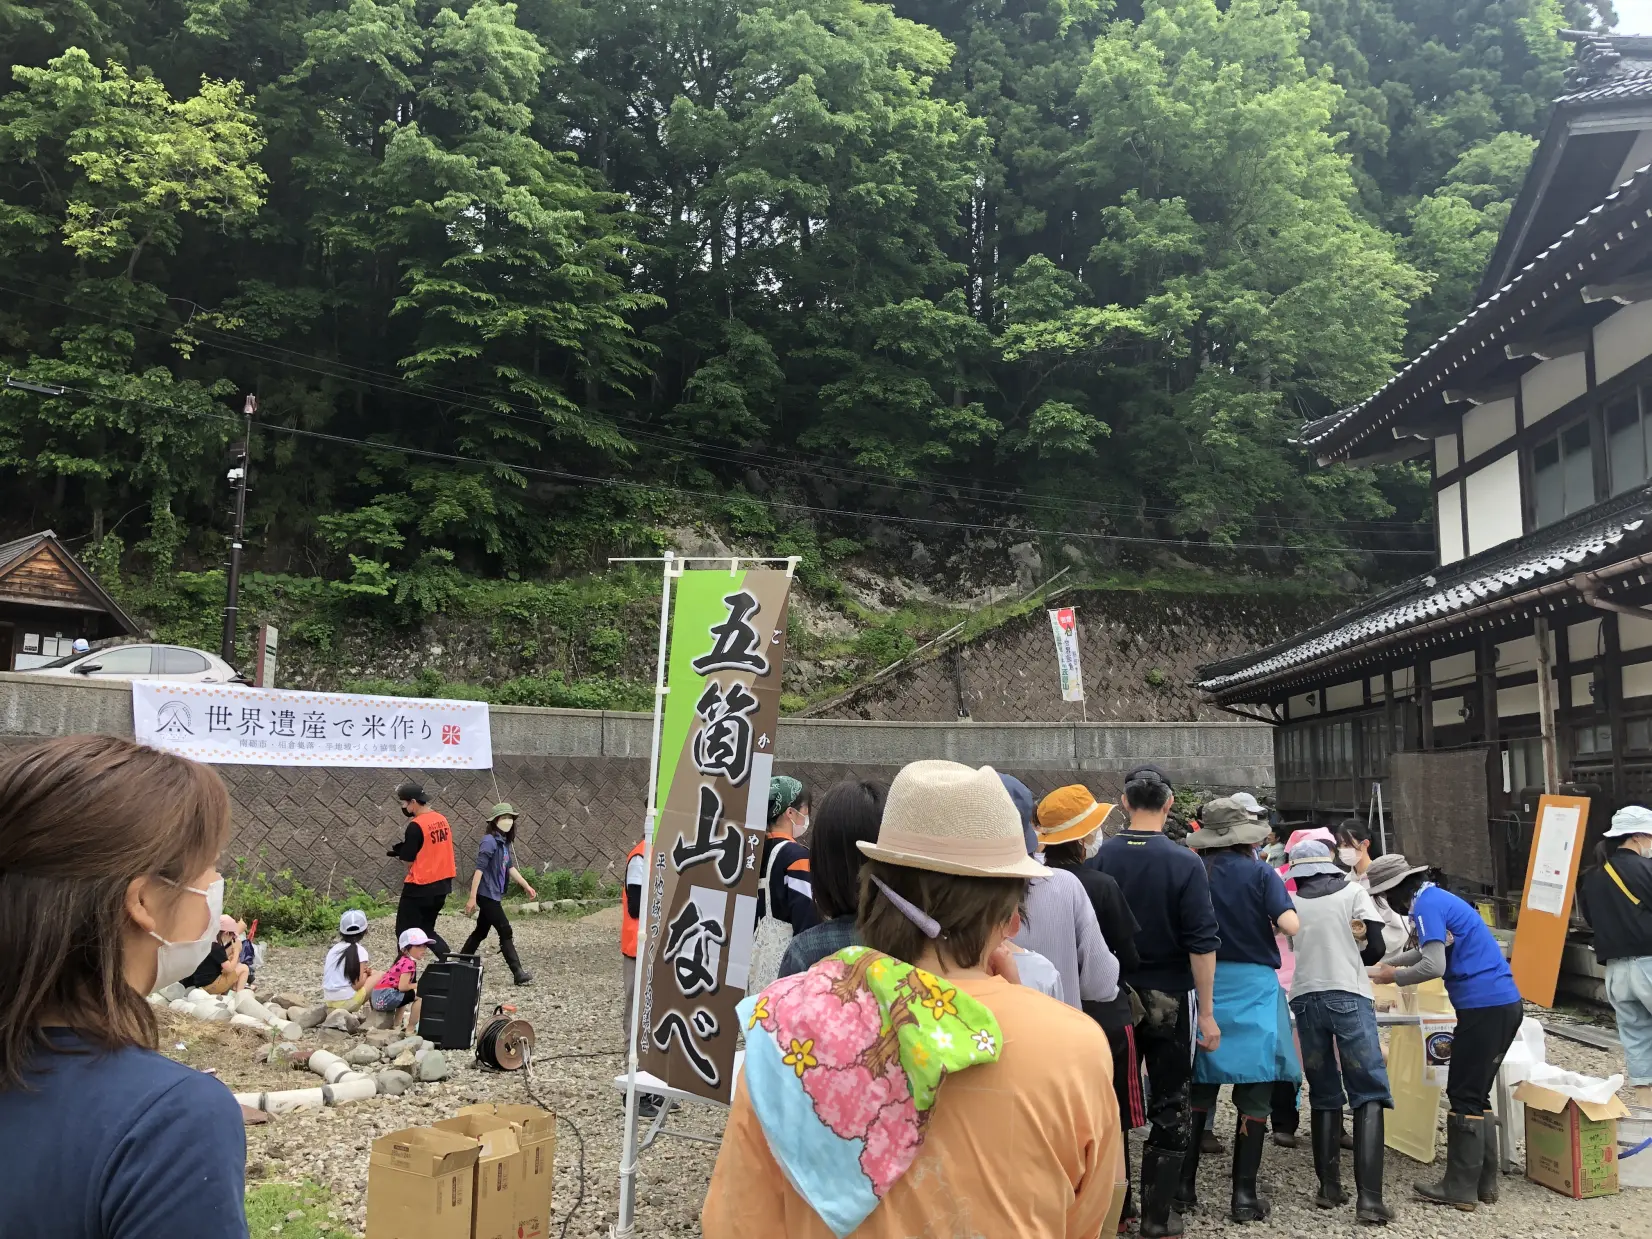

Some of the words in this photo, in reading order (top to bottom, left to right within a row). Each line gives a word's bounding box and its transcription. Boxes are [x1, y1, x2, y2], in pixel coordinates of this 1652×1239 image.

[204, 705, 433, 741] 世界遺産で米作り
[442, 724, 461, 745] 米
[653, 591, 770, 1085] 五箇山なべ
